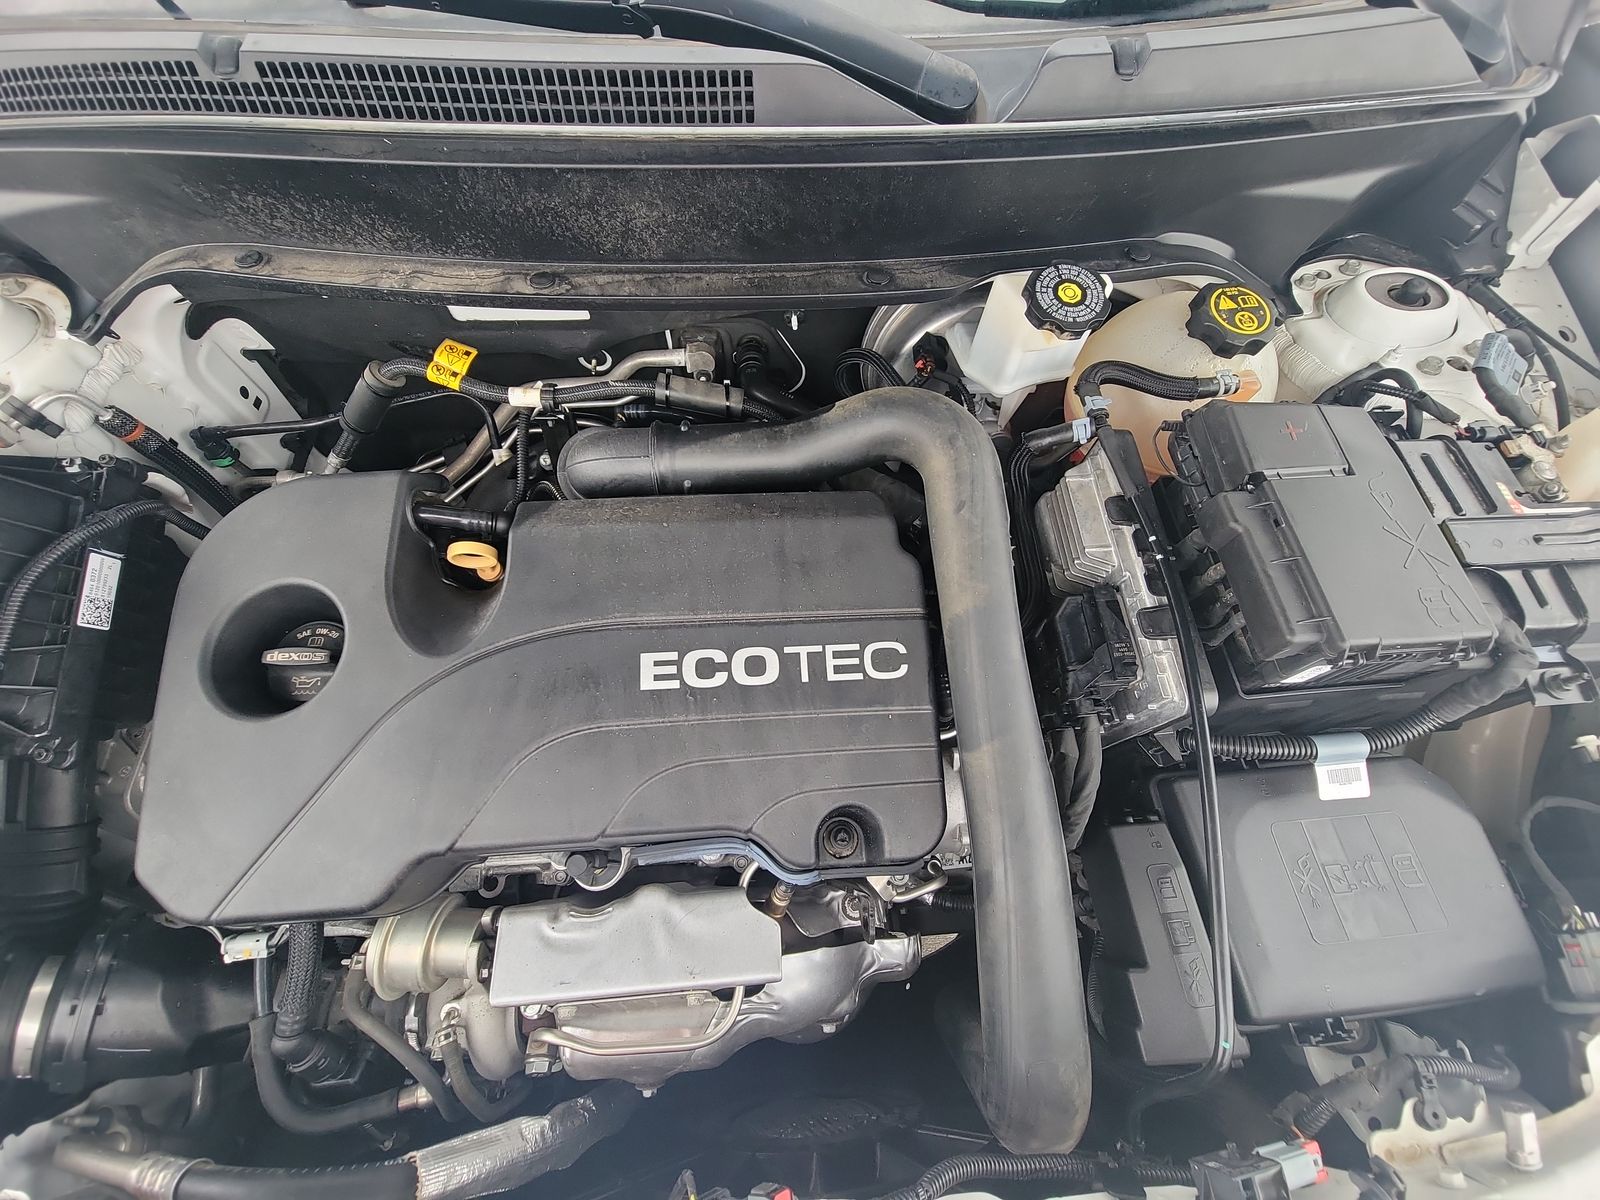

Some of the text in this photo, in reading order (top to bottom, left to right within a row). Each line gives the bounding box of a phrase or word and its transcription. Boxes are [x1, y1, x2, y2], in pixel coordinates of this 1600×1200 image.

[297, 628, 339, 639] SAE 0W-20
[266, 651, 326, 661] dexos
[639, 641, 909, 691] ECOTEC
